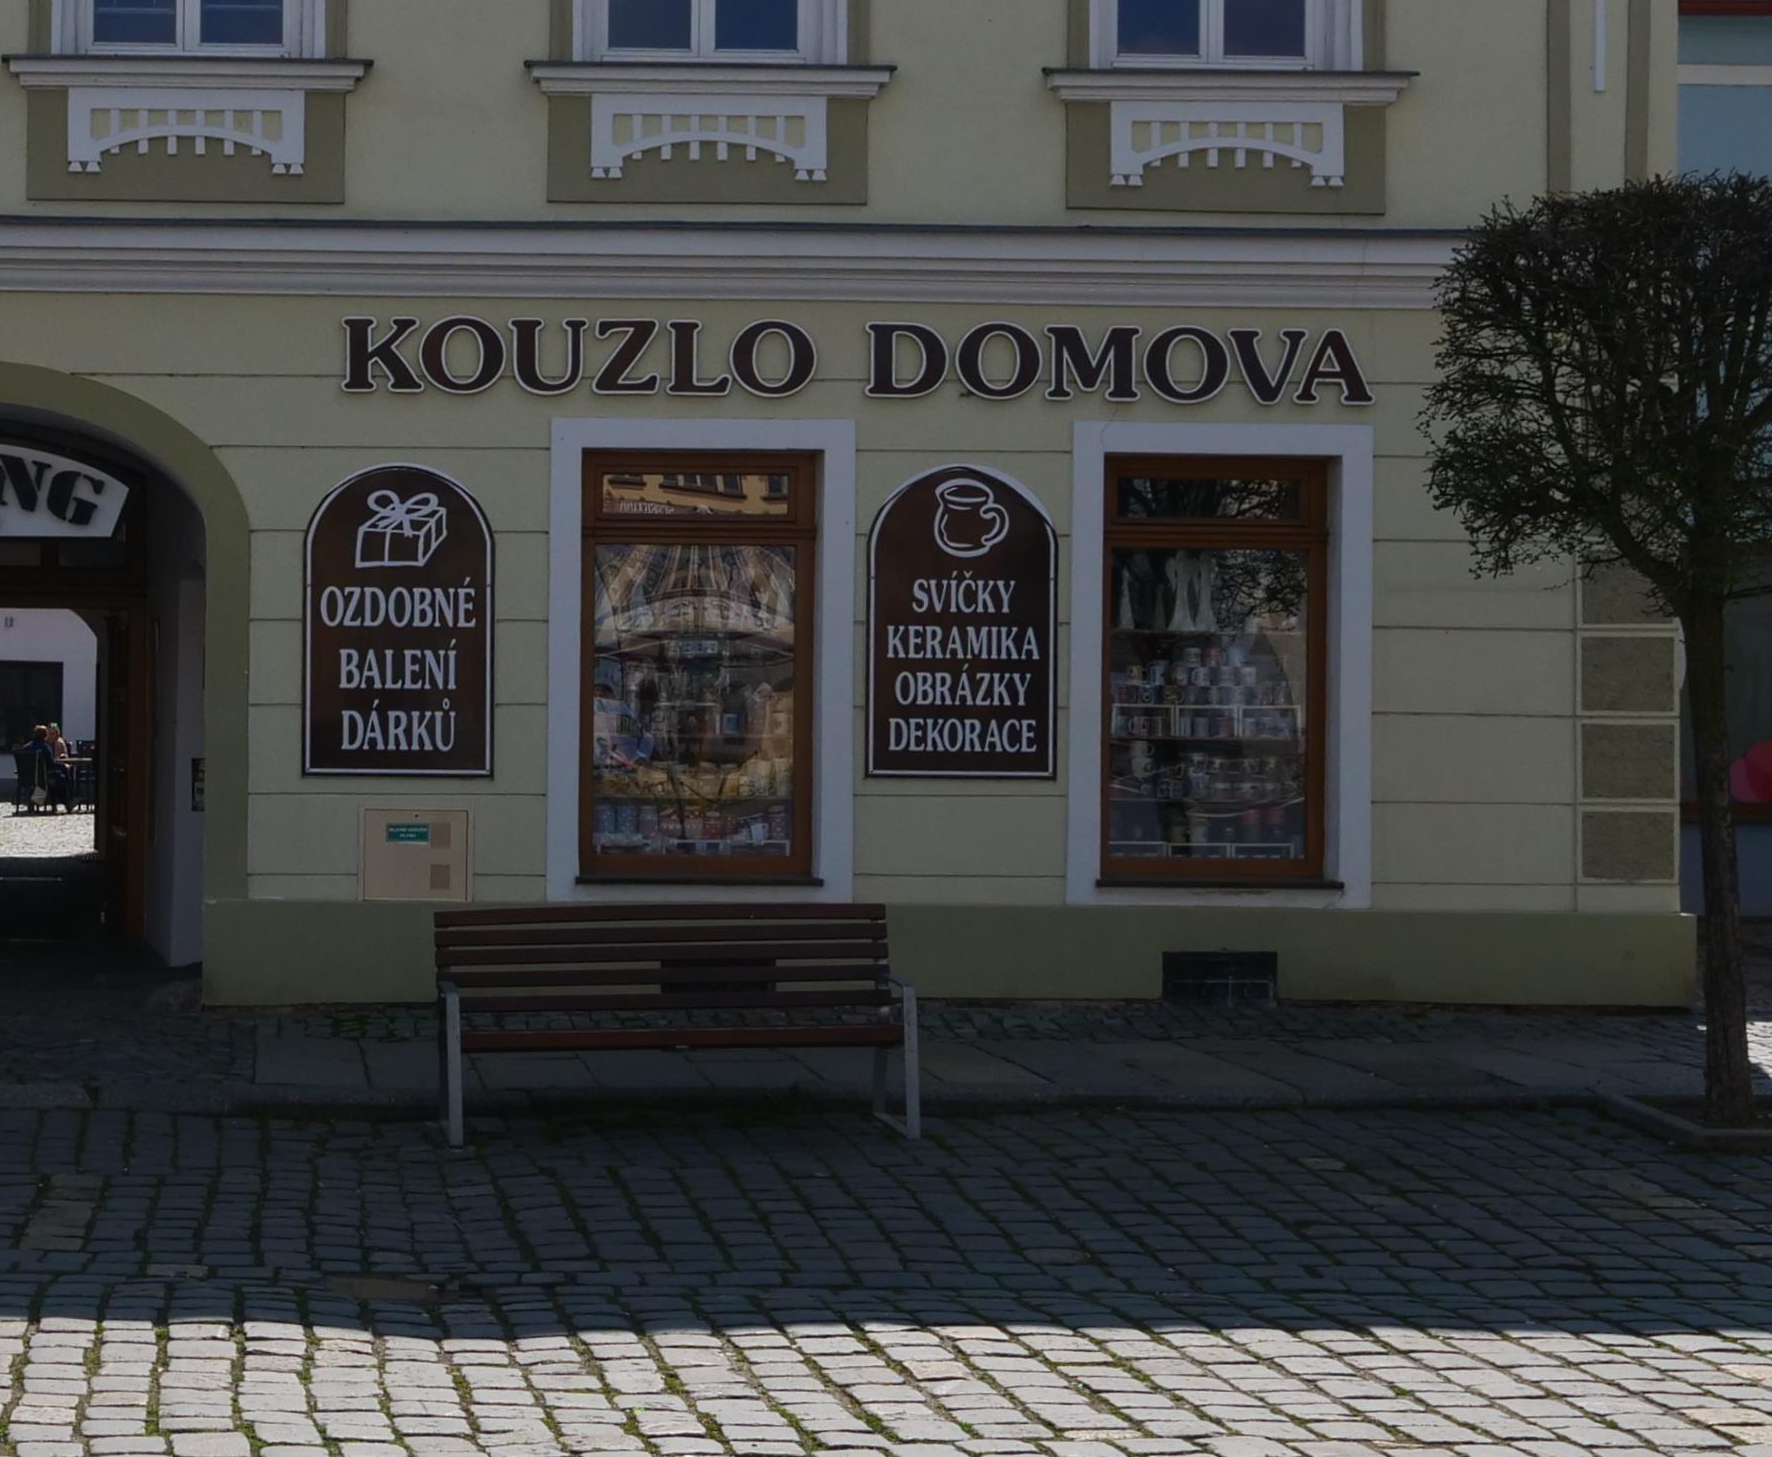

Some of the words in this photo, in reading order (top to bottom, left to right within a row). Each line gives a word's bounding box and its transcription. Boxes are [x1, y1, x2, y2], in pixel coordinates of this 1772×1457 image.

[341, 315, 817, 398] KOUZLO
[864, 321, 1375, 407] DOMOVA
[320, 577, 476, 628] OZDOBNÉ
[912, 571, 1016, 615] SVÍČKY
[339, 639, 457, 691] BALENÍ
[886, 626, 1040, 661] KERAMIKA
[895, 664, 1031, 707] OBRÁZKY
[341, 700, 456, 752] DÁRKŮ
[888, 718, 1037, 753] DEKORACE
